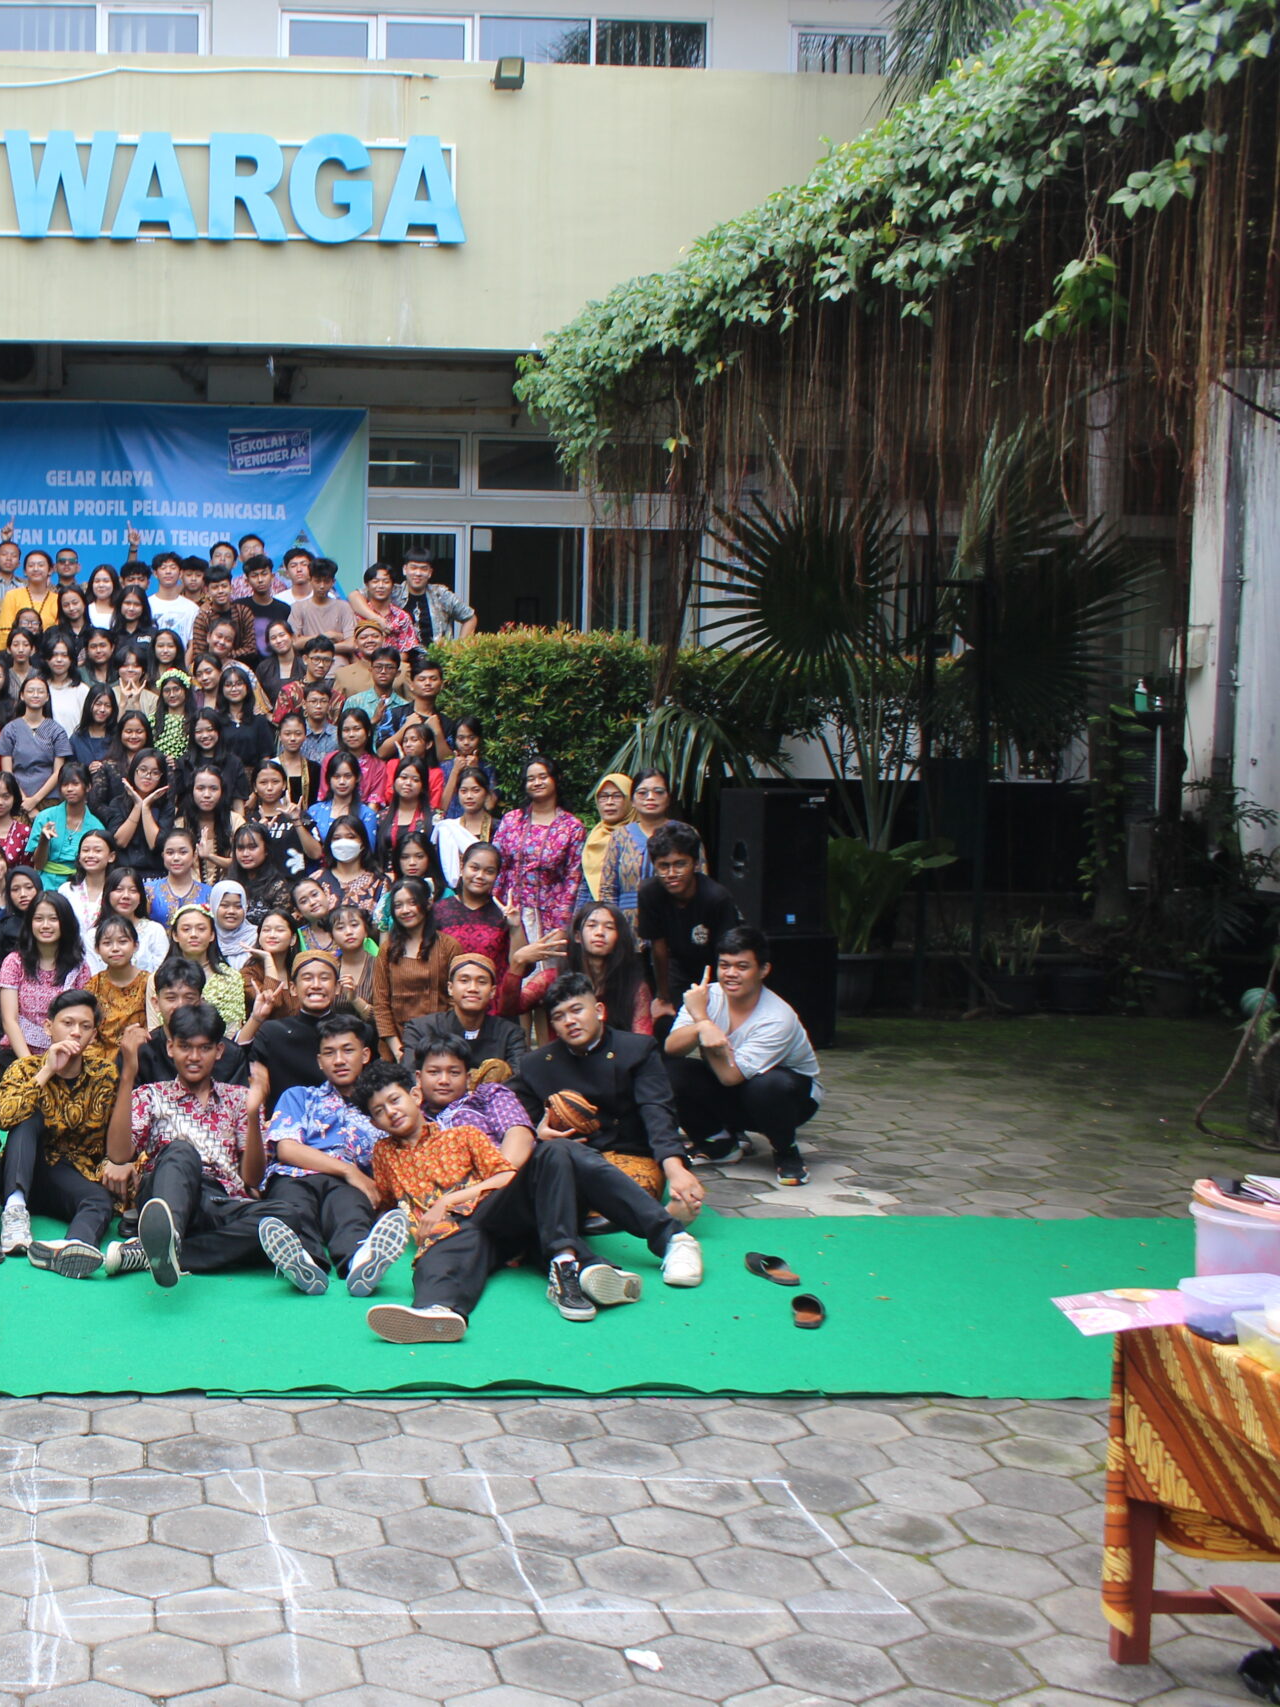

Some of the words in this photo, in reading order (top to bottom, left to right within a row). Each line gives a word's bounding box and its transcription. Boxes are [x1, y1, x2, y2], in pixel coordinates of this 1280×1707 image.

[4, 129, 467, 244] WARGA
[234, 435, 287, 455] SEKOLAH
[236, 446, 306, 469] PENGGERAK
[46, 470, 97, 487] GELAR
[101, 470, 154, 487] KARYA
[73, 499, 128, 516] PROFIL
[132, 501, 198, 518] PELAJAR
[202, 502, 287, 521] PANCASILA
[47, 528, 97, 546] LOKAL
[101, 529, 118, 546] DI
[121, 529, 166, 546] JWA
